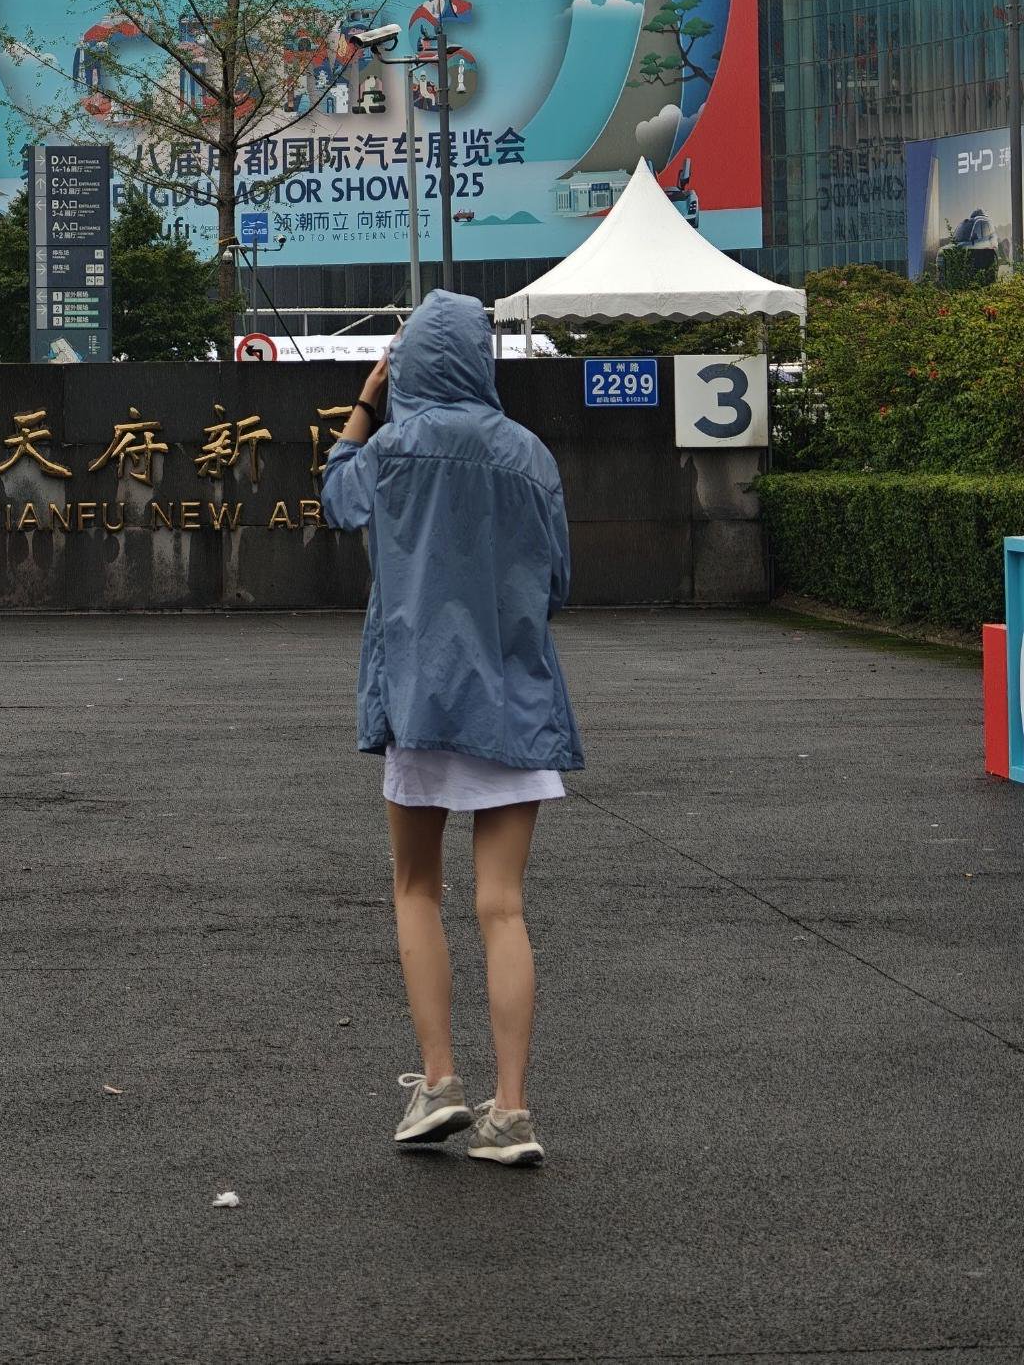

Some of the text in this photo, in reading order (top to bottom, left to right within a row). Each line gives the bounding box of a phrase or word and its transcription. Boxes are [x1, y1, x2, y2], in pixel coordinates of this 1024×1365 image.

[51, 155, 77, 165] D入口
[957, 148, 994, 174] BYD
[51, 177, 78, 188] C入口
[331, 174, 413, 202] SHOW
[51, 200, 78, 210] B入口
[52, 221, 78, 231] A入口
[273, 208, 431, 232] 领潮而立 向新而行
[272, 233, 306, 243] RAD
[332, 231, 387, 242] WESTERN
[393, 229, 431, 240] CHNA
[591, 374, 654, 395] 2299
[694, 363, 753, 439] 3
[151, 502, 244, 531] NEW
